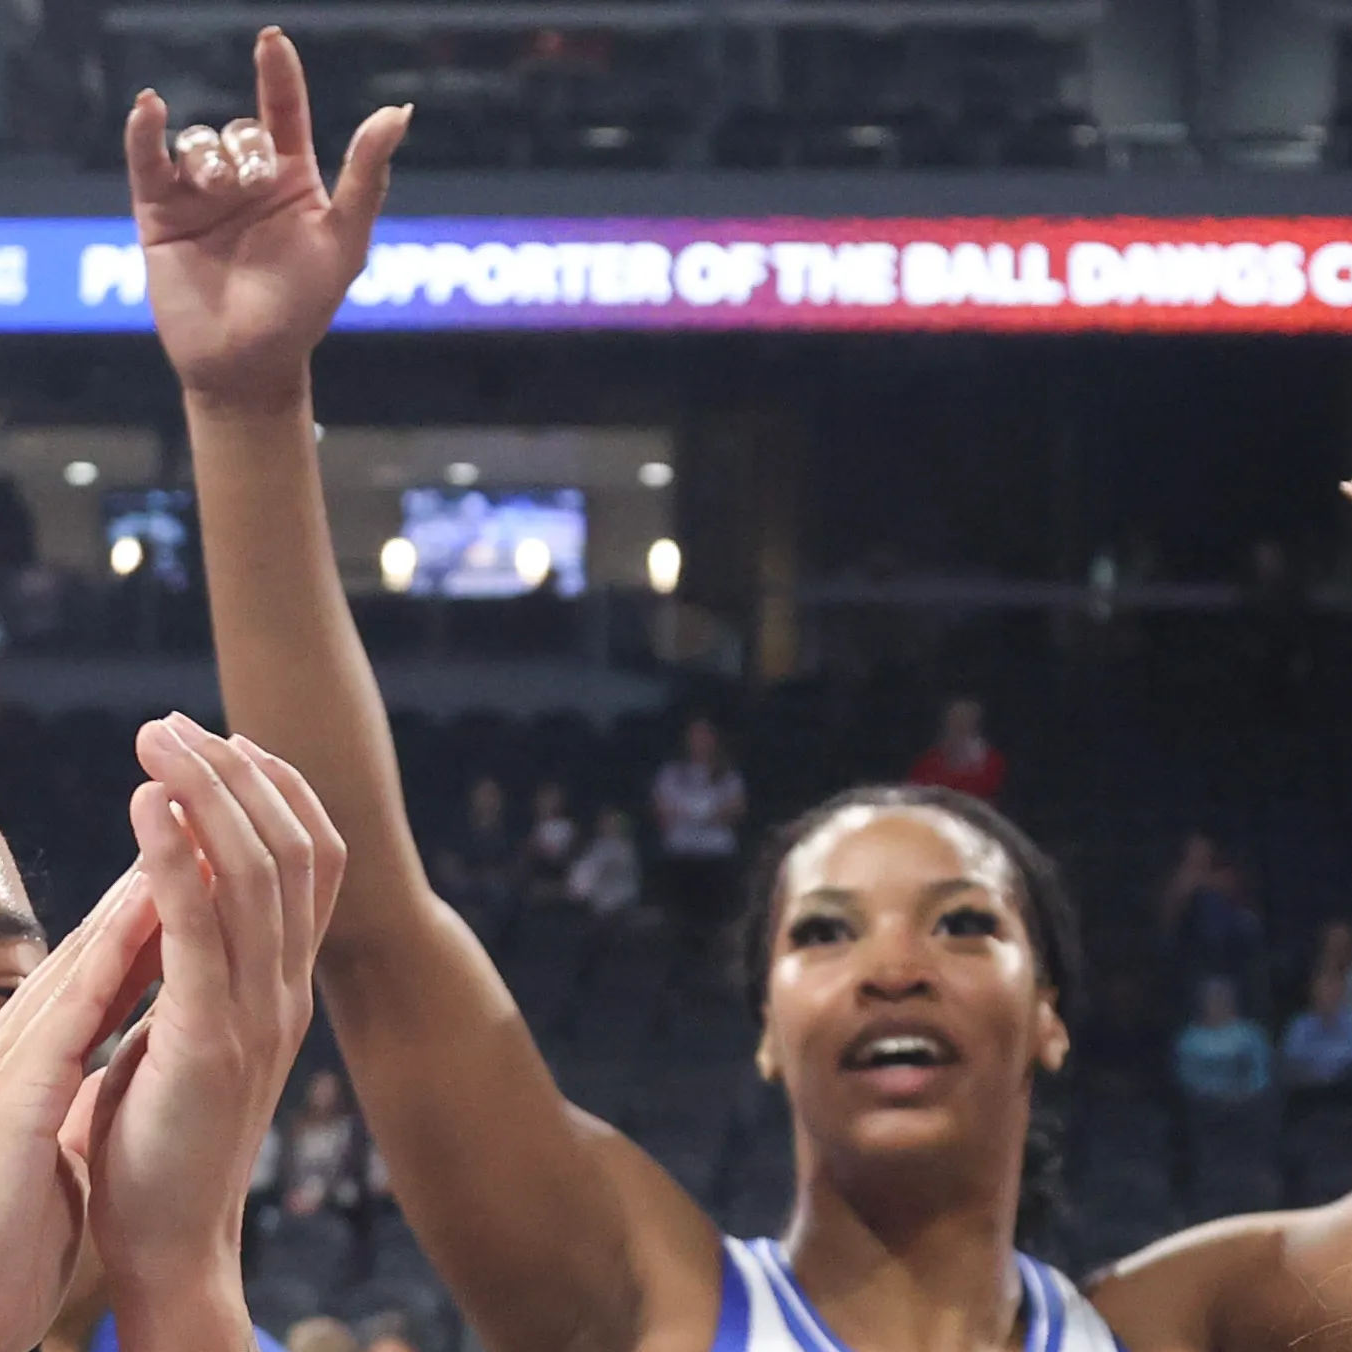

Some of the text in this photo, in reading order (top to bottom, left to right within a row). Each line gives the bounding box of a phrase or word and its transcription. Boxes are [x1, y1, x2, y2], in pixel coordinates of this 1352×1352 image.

[346, 242, 672, 306] UPPORTER
[674, 241, 767, 306] OF
[767, 241, 897, 306] THE
[900, 241, 1065, 307] BALL
[1067, 241, 1306, 307] DAWGS
